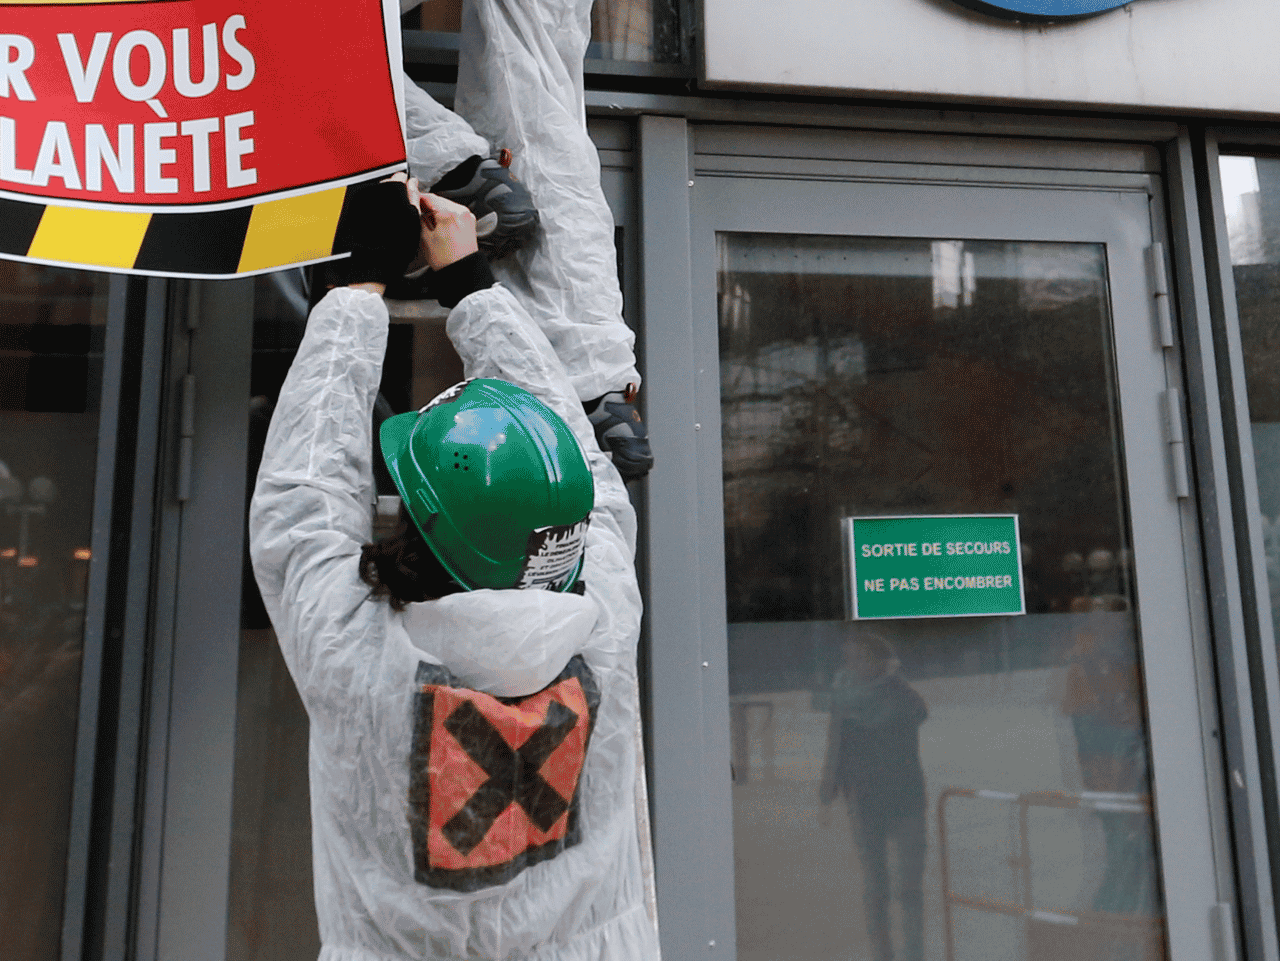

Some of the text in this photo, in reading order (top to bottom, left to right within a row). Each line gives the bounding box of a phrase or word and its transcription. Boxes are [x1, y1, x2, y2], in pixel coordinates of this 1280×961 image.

[57, 14, 255, 105] VOUS
[861, 541, 1012, 557] SORTIE DE SECOURS
[864, 575, 1013, 592] NE PAS ENCOMBRER
